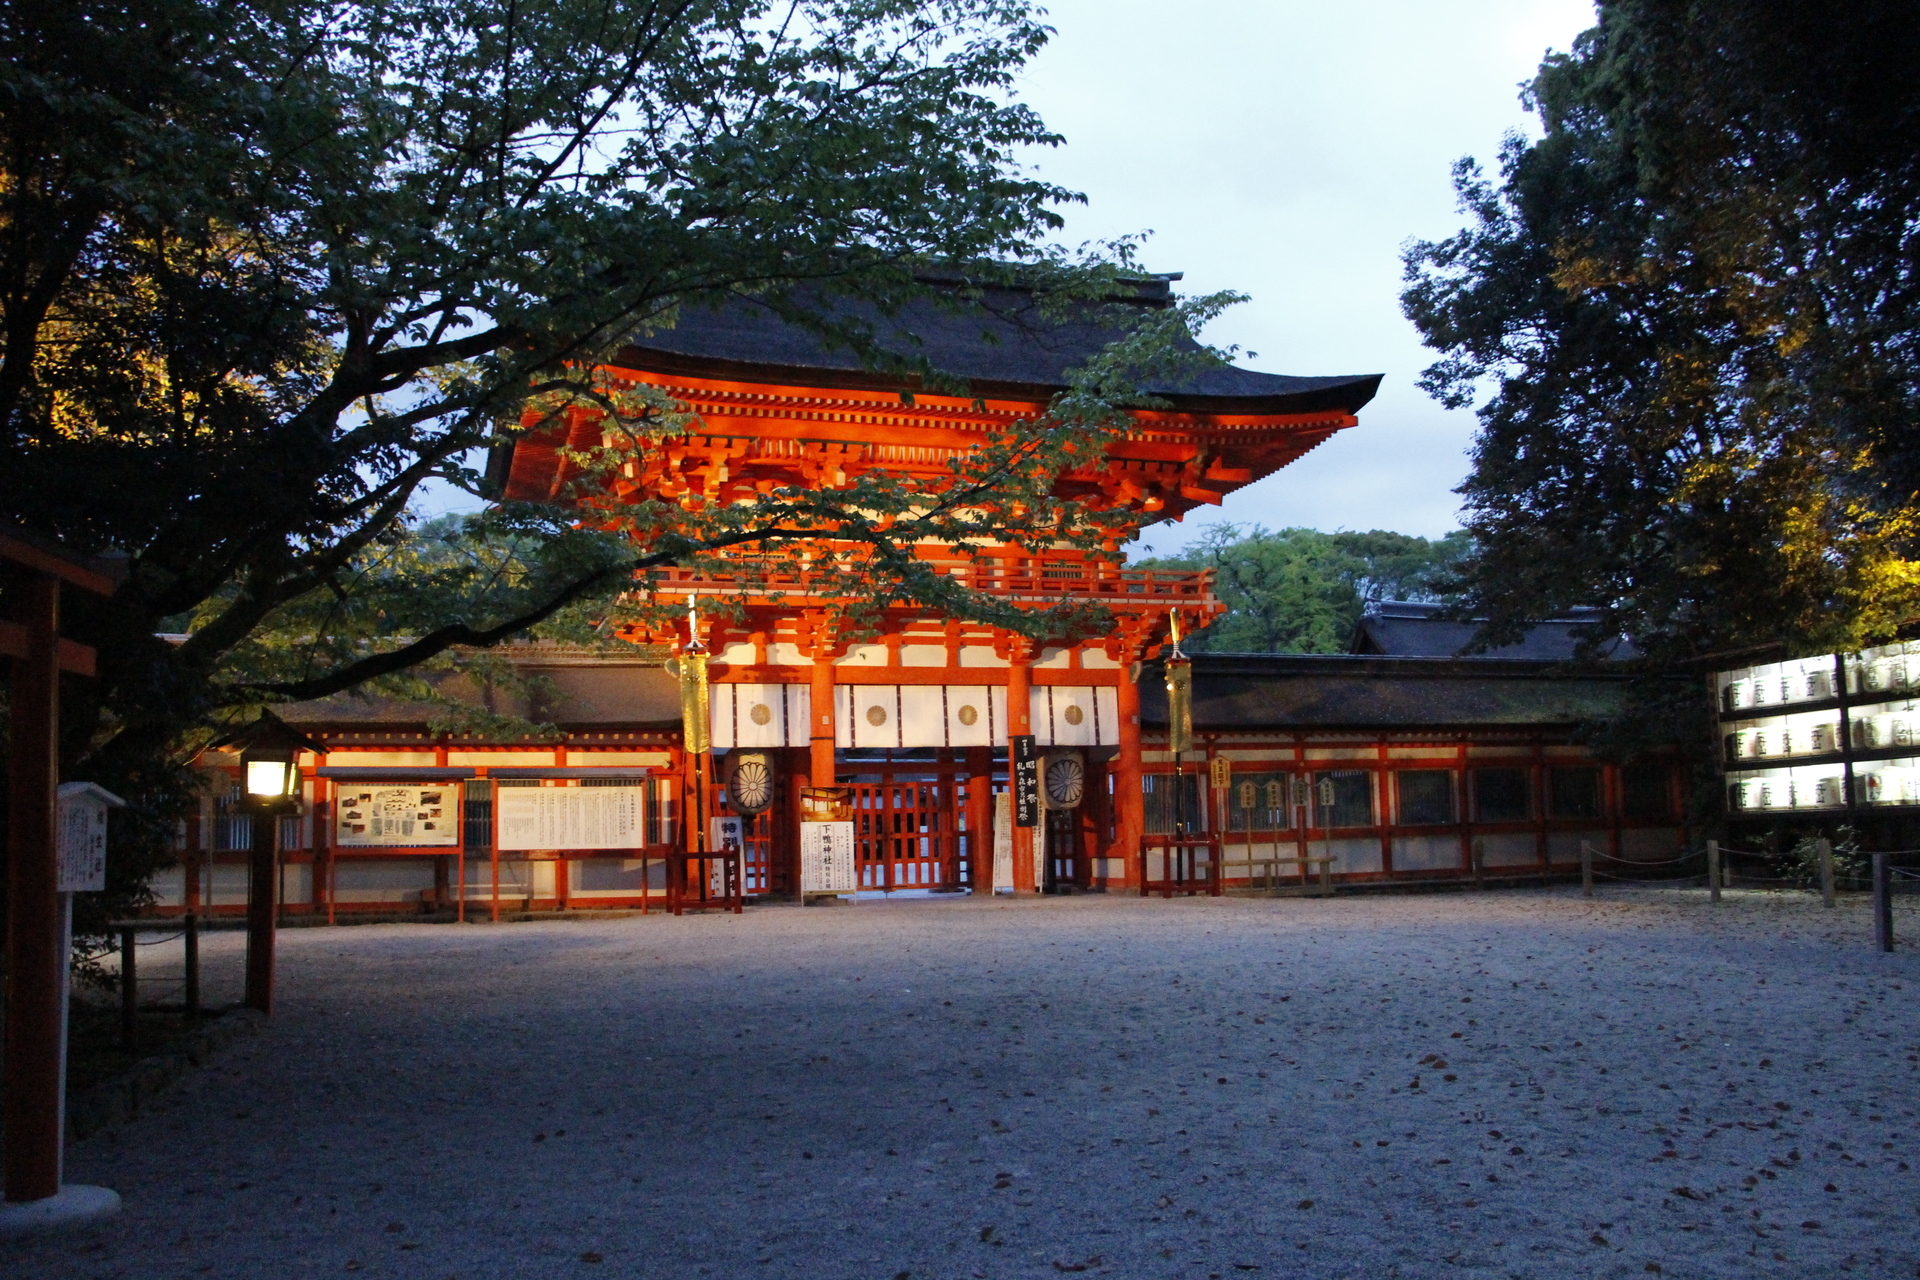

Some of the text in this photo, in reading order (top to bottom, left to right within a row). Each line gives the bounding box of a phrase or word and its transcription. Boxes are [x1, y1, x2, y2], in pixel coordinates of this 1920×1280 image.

[1025, 760, 1037, 804] 昭和祭
[822, 824, 833, 865] 下鴨神社
